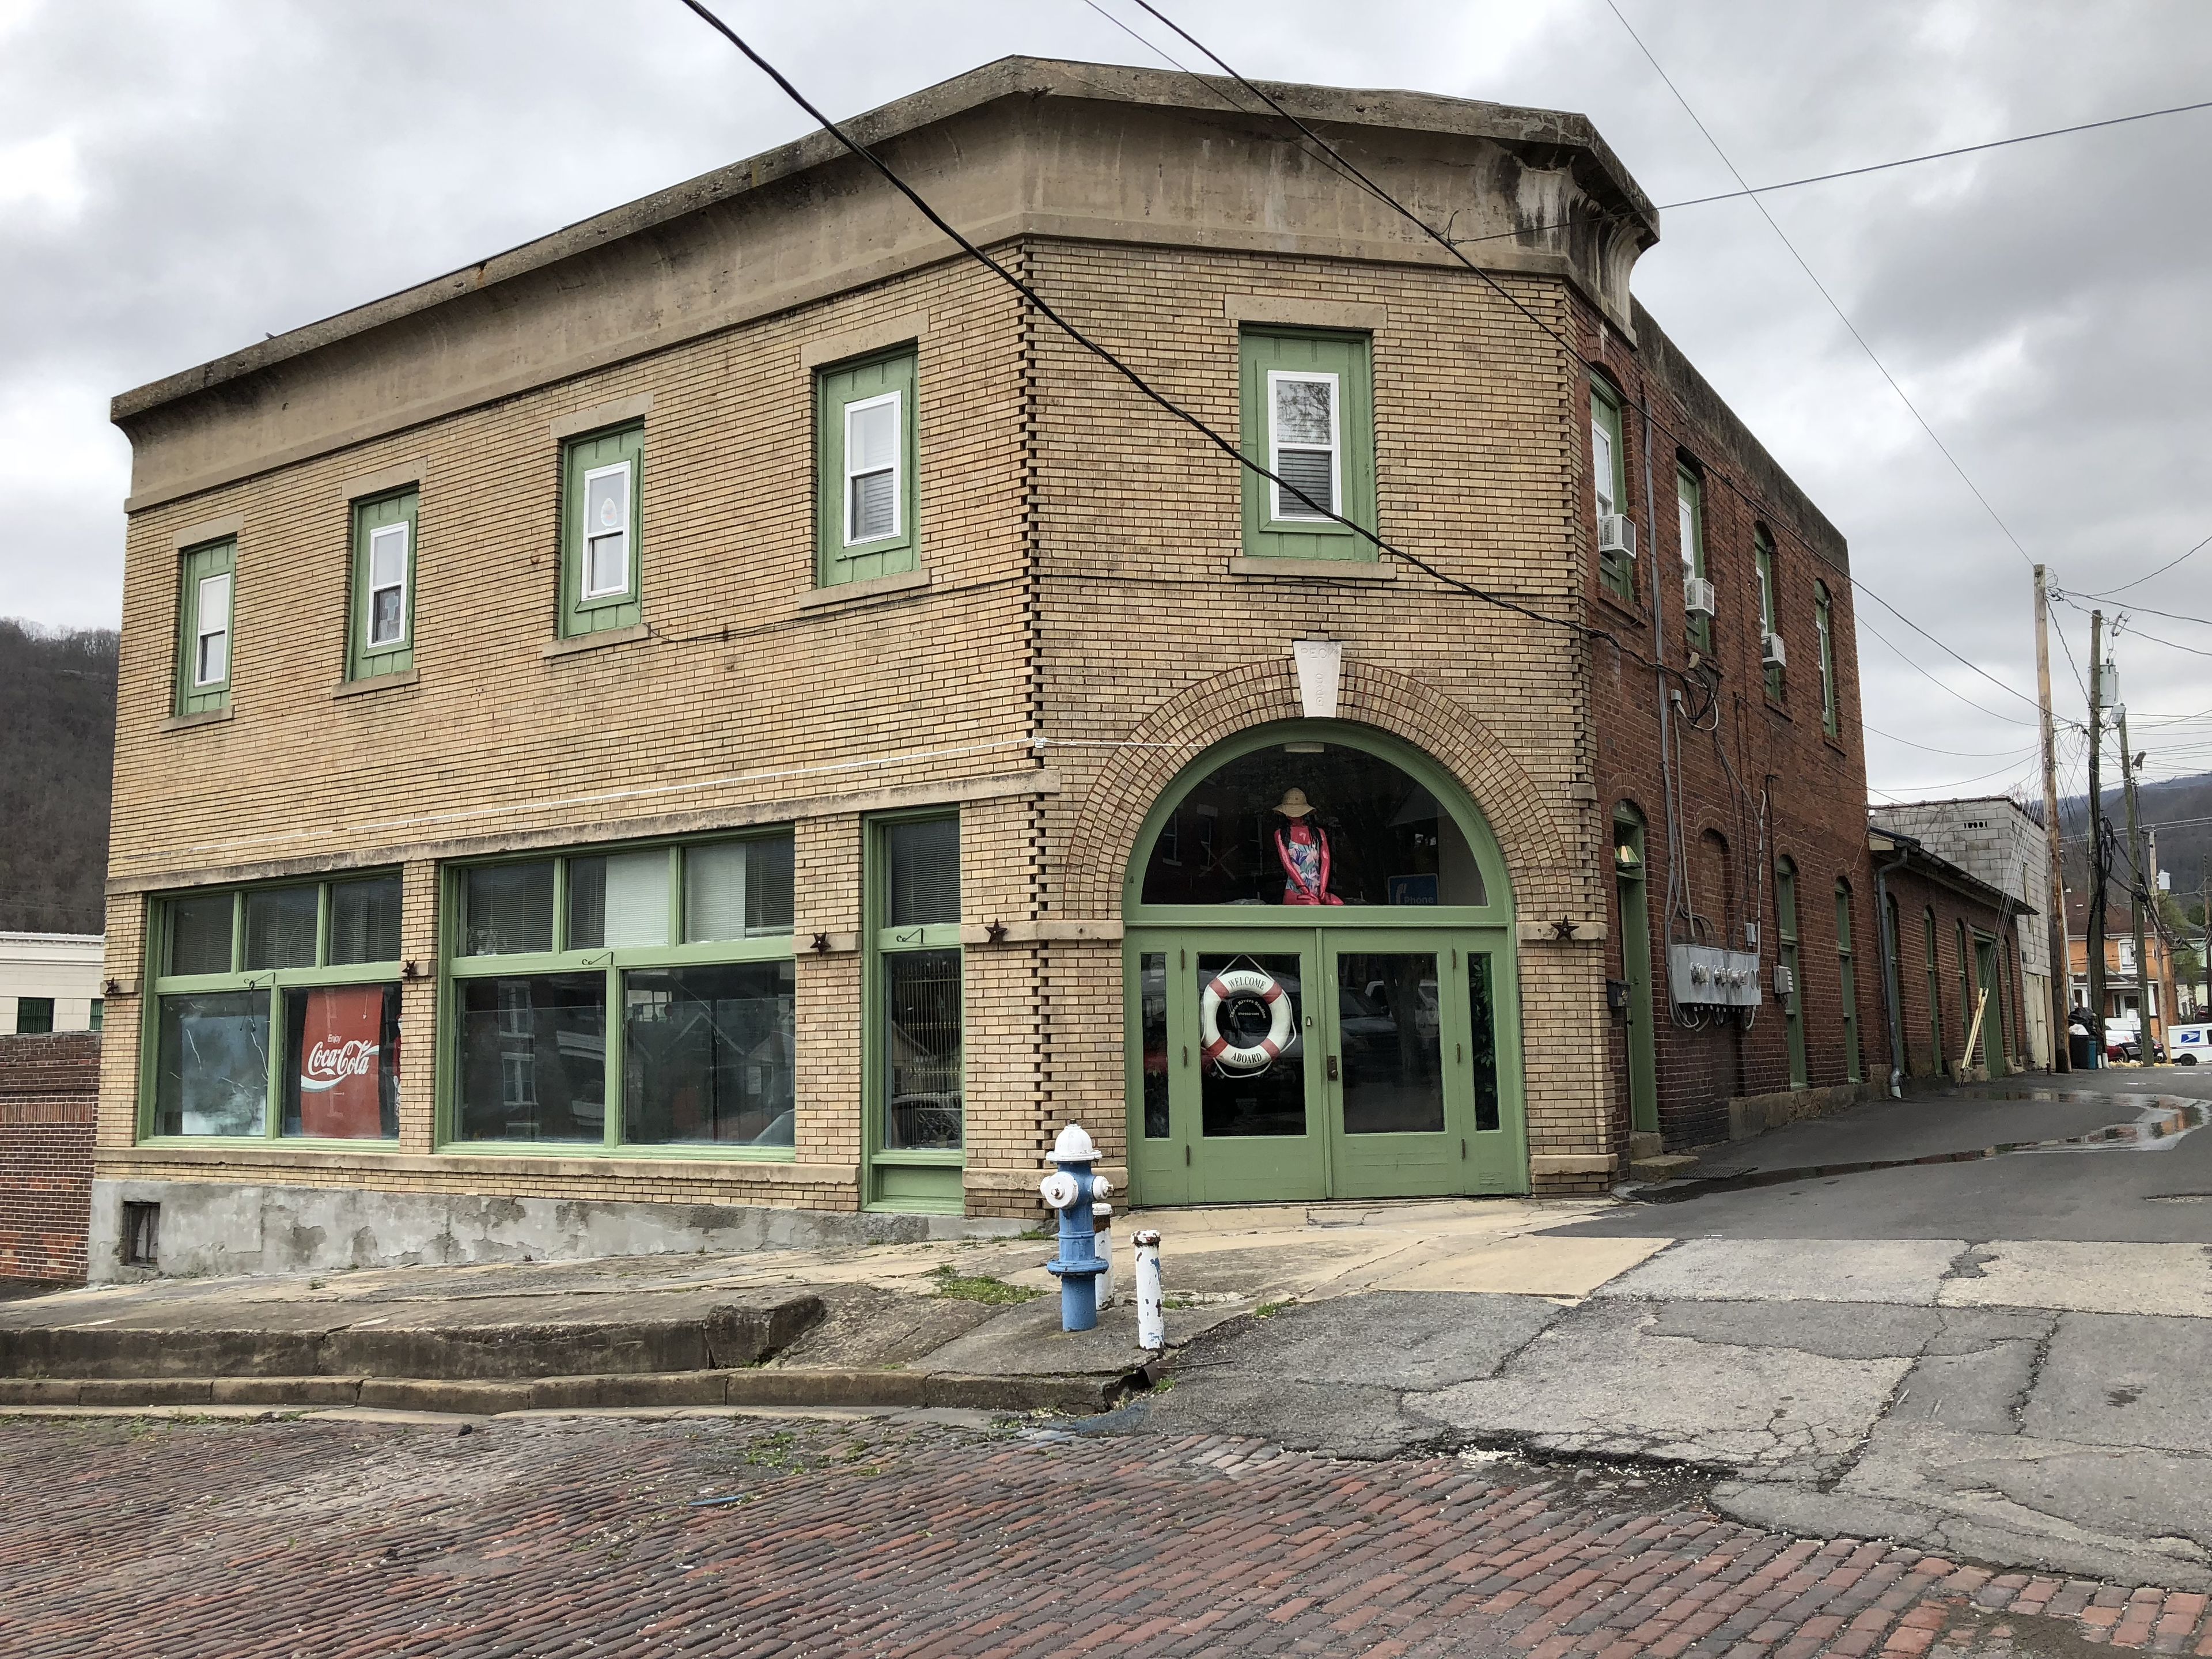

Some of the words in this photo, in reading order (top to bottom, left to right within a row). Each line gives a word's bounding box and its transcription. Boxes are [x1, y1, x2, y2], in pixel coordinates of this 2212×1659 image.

[1228, 976, 1266, 990] WELCOME
[327, 1034, 342, 1044] Enjoy
[308, 1040, 373, 1076] Coca-Cola
[1230, 1051, 1262, 1064] ABOARD
